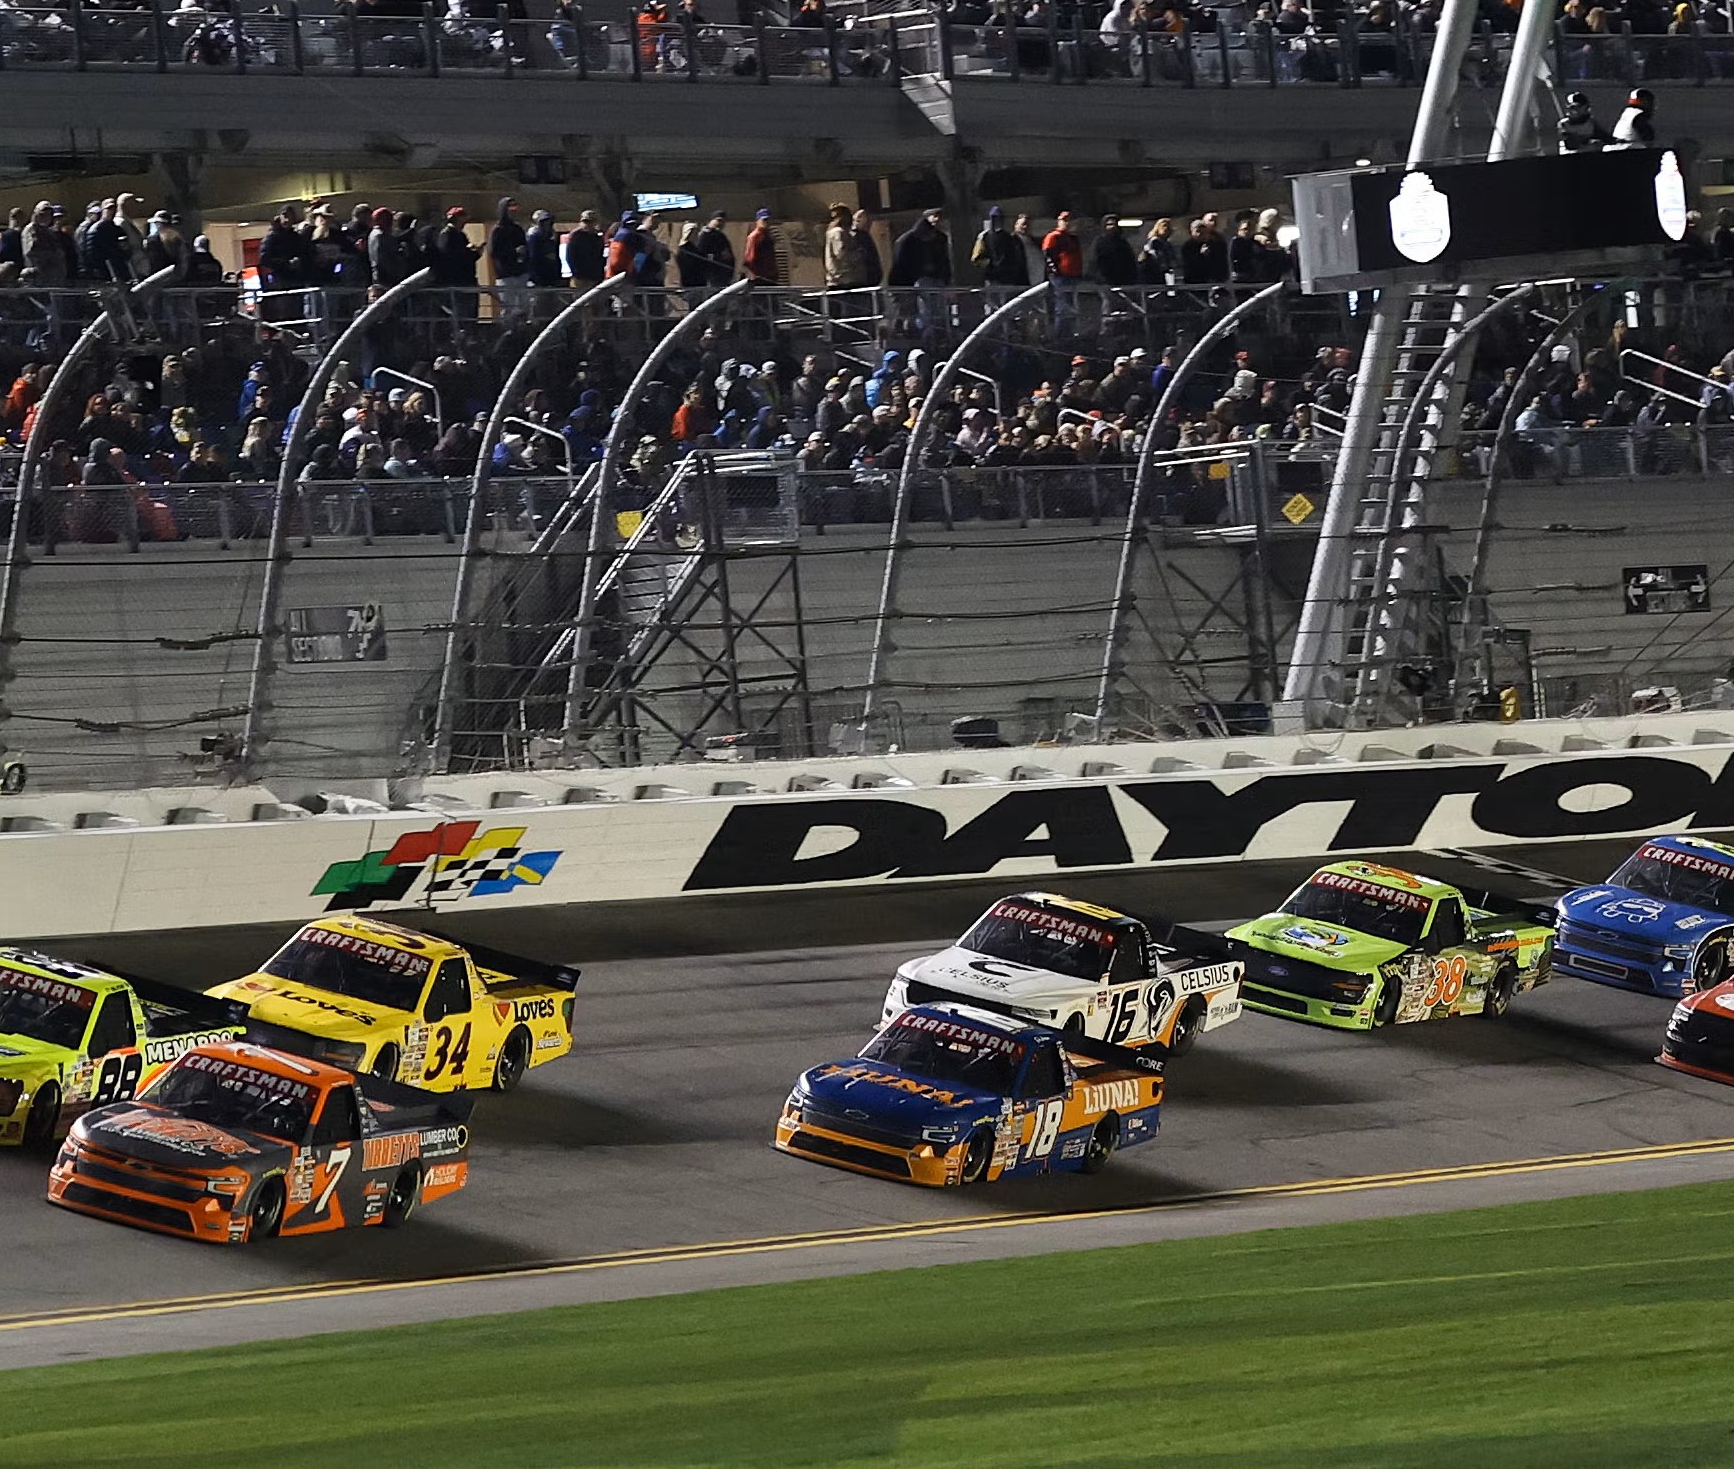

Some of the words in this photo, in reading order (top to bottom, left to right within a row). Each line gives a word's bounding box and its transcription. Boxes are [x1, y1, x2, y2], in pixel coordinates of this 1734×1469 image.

[1317, 873, 1420, 908] CRAFTSMAN
[995, 904, 1102, 942] CRAFTSMAN
[300, 929, 430, 971] CRAFTSMAN
[1181, 965, 1229, 991] CELSIUS
[1424, 955, 1466, 1007] 38
[902, 1015, 1017, 1054] CRAFTSMAN
[1106, 986, 1142, 1043] 16
[424, 1023, 473, 1081] 34
[1136, 1056, 1164, 1072] CORE
[185, 1056, 307, 1098] CRAFTSMAN
[1026, 1099, 1064, 1159] 18
[315, 1148, 351, 1214] 7
